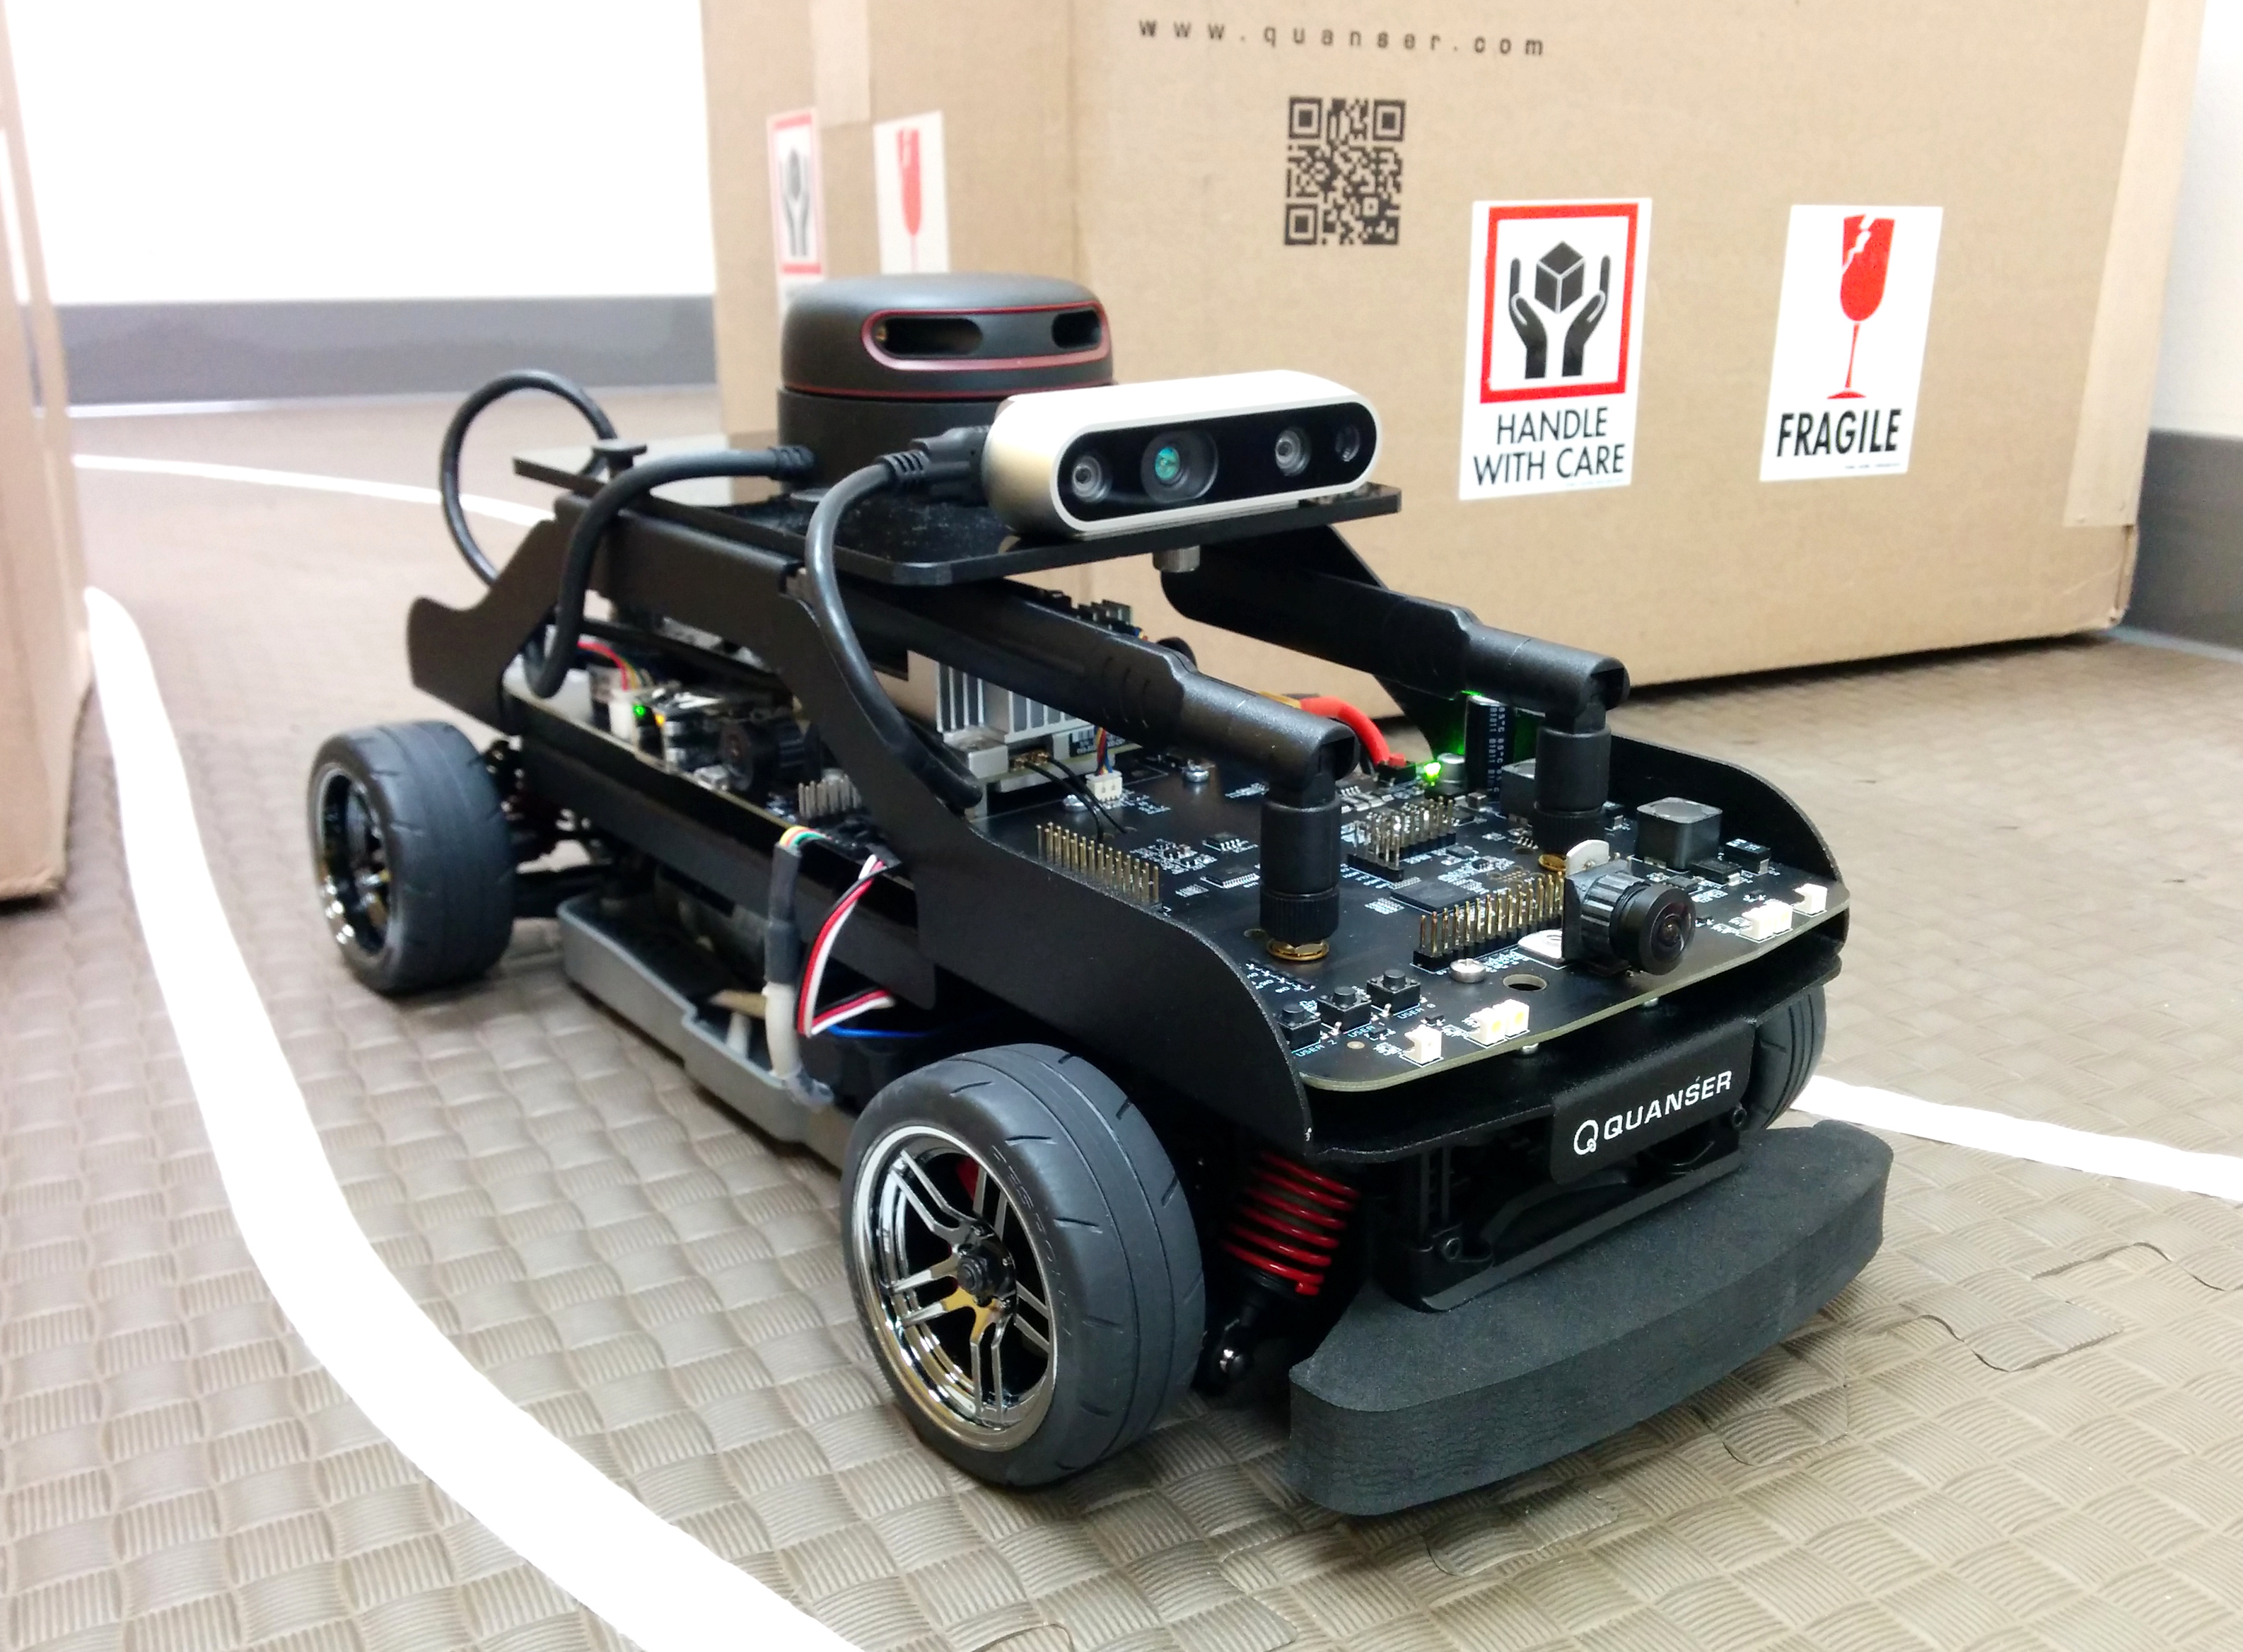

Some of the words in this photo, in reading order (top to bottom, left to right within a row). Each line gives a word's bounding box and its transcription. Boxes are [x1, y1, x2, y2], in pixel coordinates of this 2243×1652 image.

[1139, 20, 1543, 56] www.quanser.com
[1497, 407, 1607, 445] HANDLE
[1776, 408, 1902, 458] FRAGILE
[1474, 450, 1545, 486] WITH
[1556, 443, 1625, 478] CARE
[1347, 1024, 1376, 1038] USER
[1397, 1007, 1425, 1020] USER
[1295, 1044, 1326, 1057] USER
